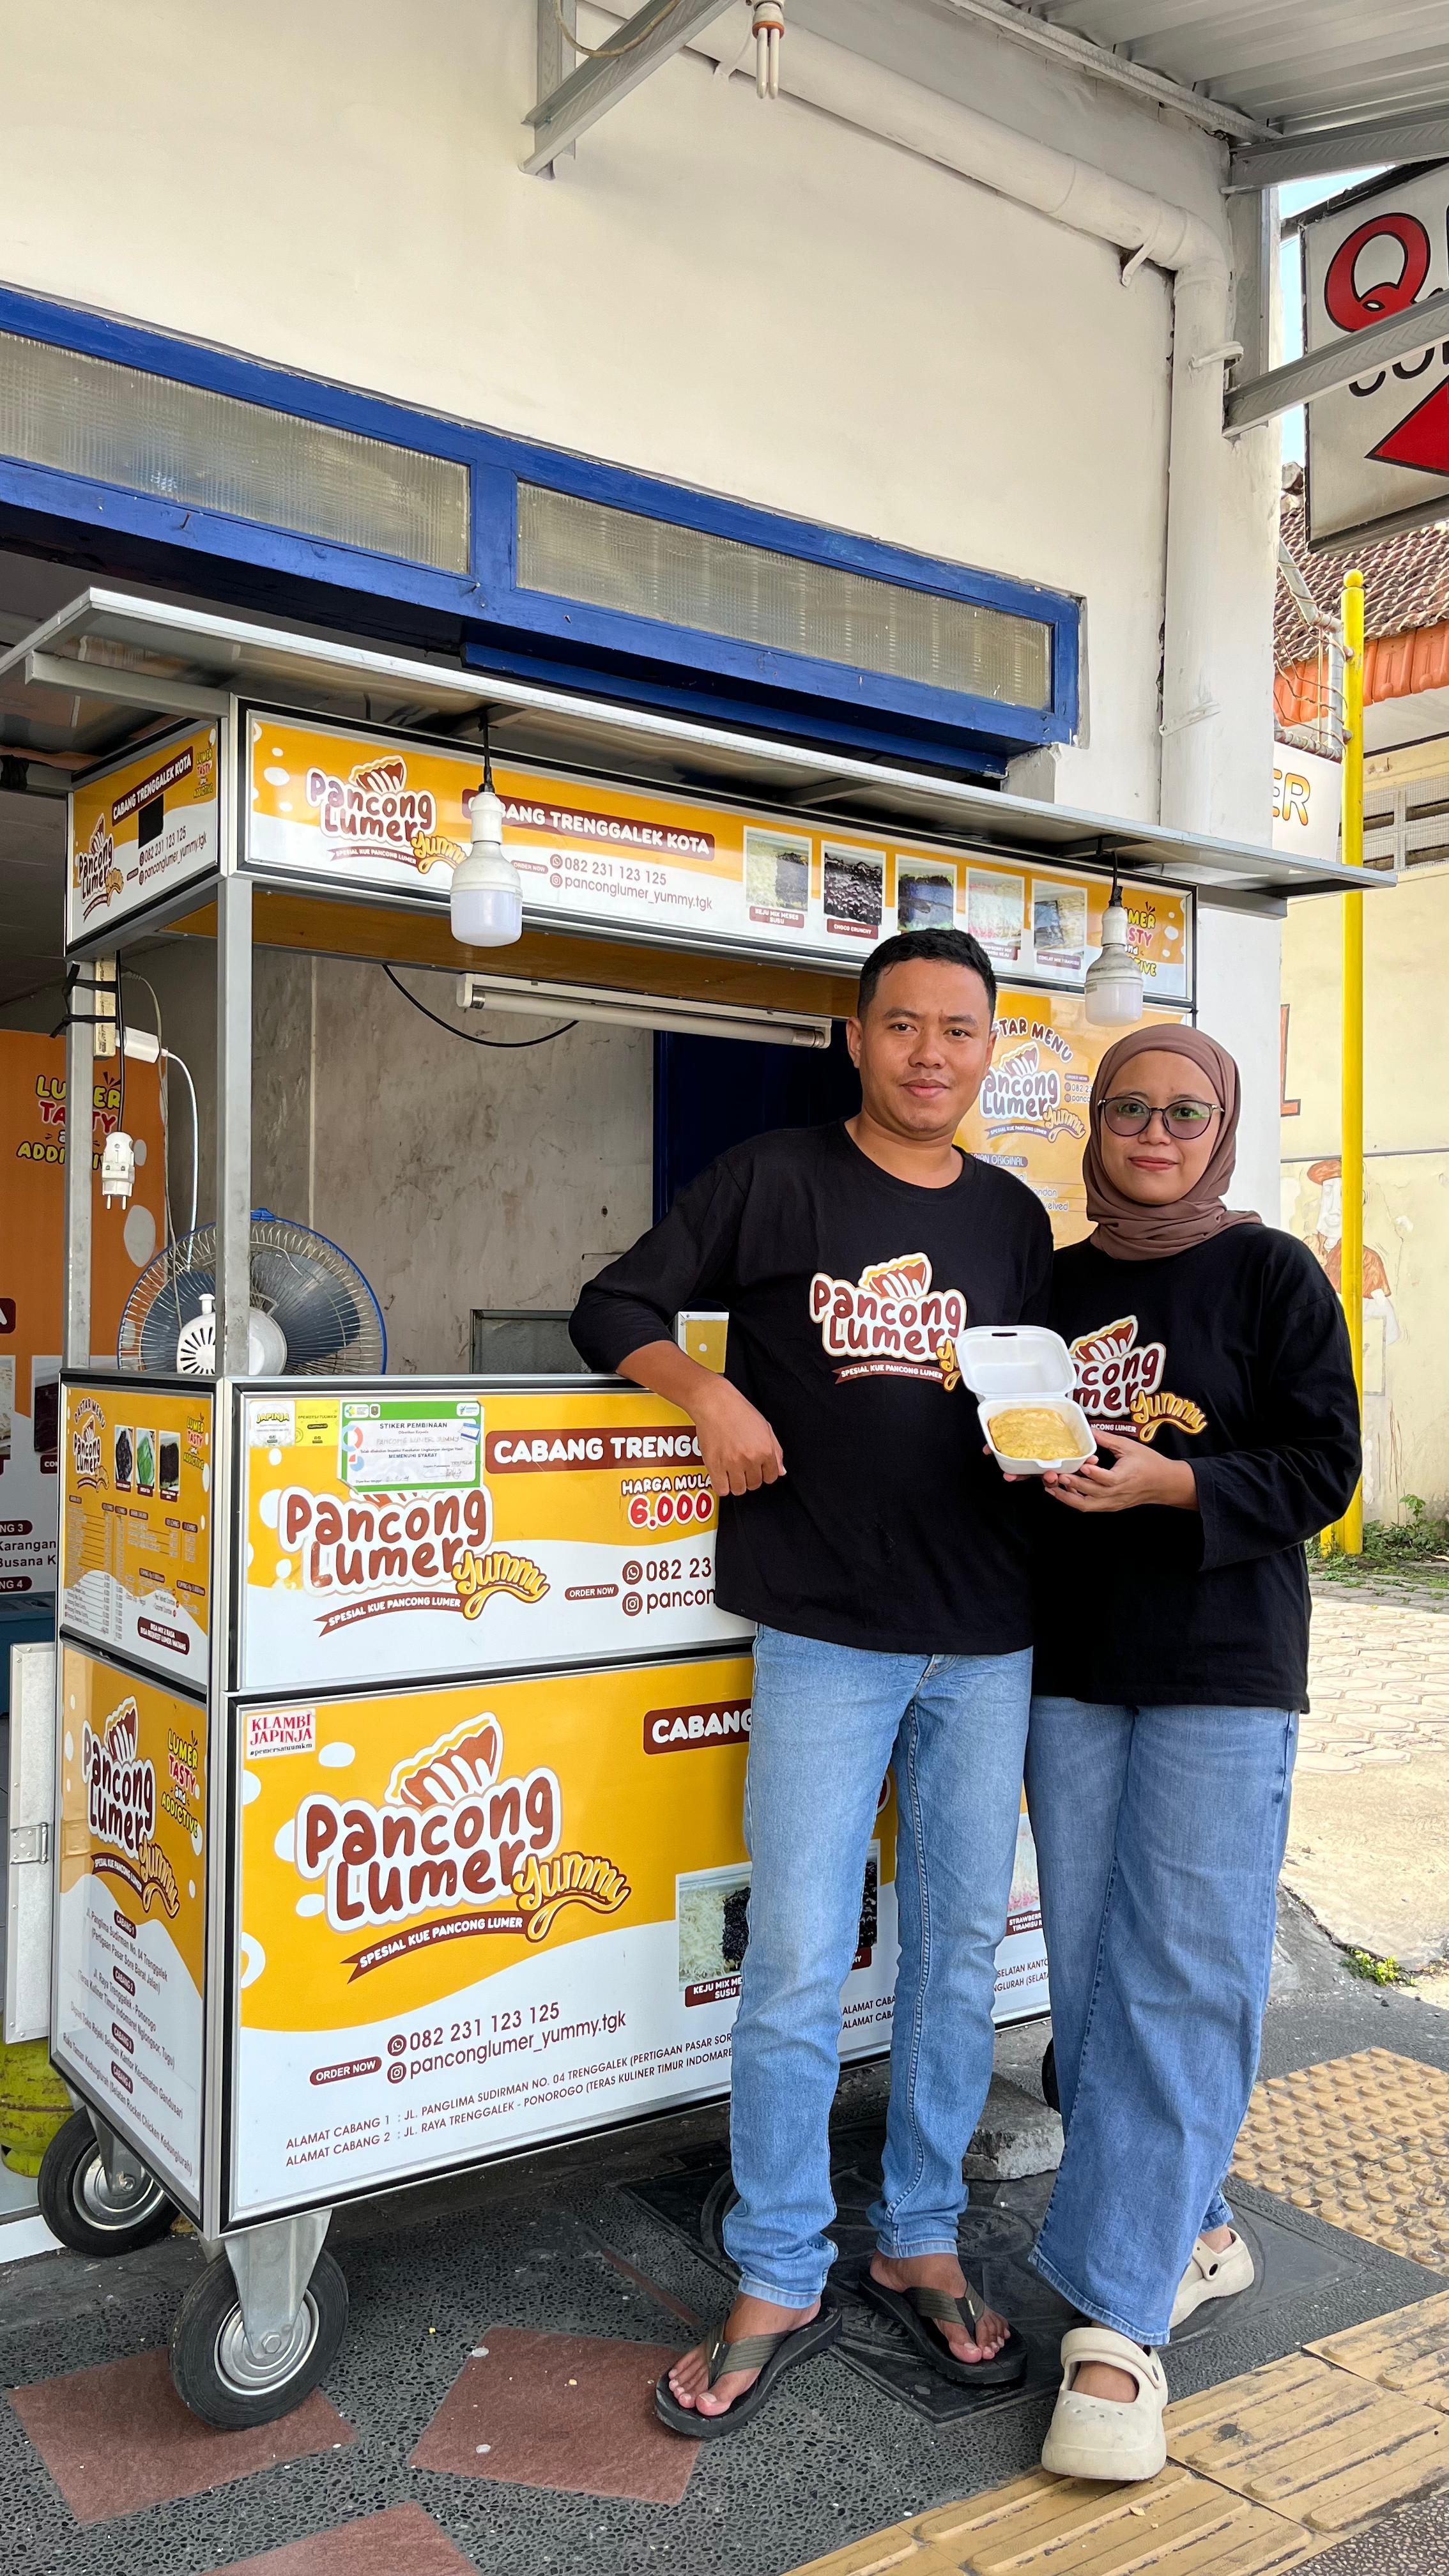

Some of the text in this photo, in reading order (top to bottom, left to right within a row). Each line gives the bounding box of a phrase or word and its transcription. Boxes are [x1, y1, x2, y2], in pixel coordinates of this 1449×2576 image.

[113, 793, 136, 820] CABANG
[137, 765, 174, 802] TRENGGALEK
[175, 754, 192, 777] KOTA
[311, 772, 433, 830] Pancong
[325, 804, 418, 843] Lumer
[550, 811, 710, 855] TRENGGALEK KOTA
[79, 838, 113, 878] Pancong
[144, 825, 187, 863] 082 231 123 125
[371, 849, 397, 859] PANCONG
[398, 854, 417, 864] LUMER
[514, 862, 546, 873] ORDER NOW
[565, 857, 666, 886] 082 231 123 125
[565, 876, 713, 912] panconglumer_yummy.tgk
[1032, 1023, 1072, 1061] MENU
[36, 1075, 121, 1109] LUER
[983, 1089, 1048, 1117] Lumer
[985, 1070, 1057, 1105] ancong
[40, 1101, 117, 1133] TATY
[992, 1156, 1023, 1166] ORIGINAL
[814, 1280, 961, 1338] Pancong
[829, 1315, 945, 1355] Lumer
[841, 1364, 943, 1380] SPESIAL KUE PANCONG LUMER
[256, 1412, 290, 1424] JAPINJA
[1115, 1425, 1137, 1433] LUMER
[494, 1438, 604, 1464] CABANG
[622, 1475, 714, 1496] HARGA MULA
[287, 1489, 486, 1547] Pancong
[629, 1492, 713, 1527] 6.000
[17, 1524, 24, 1533] 3
[310, 1537, 464, 1588] Lumer
[646, 1557, 712, 1582] 082 23
[17, 1579, 23, 1589] 4
[452, 1549, 551, 1620] yummy
[569, 1586, 615, 1598] ORDER NOW
[328, 1597, 461, 1627] SPESIAL KUE PANCONG LUMER
[250, 1728, 312, 1745] JAPINJA
[252, 1713, 311, 1732] KLAMBI
[652, 1708, 752, 1744] CABANG
[168, 1728, 198, 1770] LUMER
[250, 1742, 312, 1757] #pemersatuumkm
[84, 1727, 153, 1832] Pancong
[169, 1754, 195, 1795] TASTY
[174, 1785, 187, 1805] and
[90, 1779, 143, 1851] Lumer
[161, 1791, 198, 1838] ADDICTIVE
[306, 1776, 553, 1869] Pancong
[336, 1839, 526, 1921] Lumer
[514, 1851, 632, 1943] yummy
[359, 1917, 523, 1970] SPESIAL KUE PANCONG LUMER
[1013, 1920, 1038, 1932] TIRAMISU
[693, 1979, 730, 1995] KEJU MIX
[997, 1963, 1025, 1979] SELATAN
[714, 1988, 736, 1999] SUSU
[842, 1995, 895, 2016] ALAMAT CABA
[410, 2002, 560, 2051] 082 231 123 125
[842, 2014, 873, 2030] ALAMAT
[410, 2010, 627, 2080] panconglumer_yummy.tgk
[316, 2060, 376, 2082] ORDER NOW
[286, 2032, 732, 2149] ALAMAT CABANG 1 JL. PANGLIMA SUDIRMAN NO. 04 TRENGGALEK (PERTIGAAN PASAR SOR
[286, 2048, 732, 2167] ALAMAT CABANG 2 JL. RAYA TRENGGALEK PONOROGO (TERAS KULINER TIMUR INDOMARE
